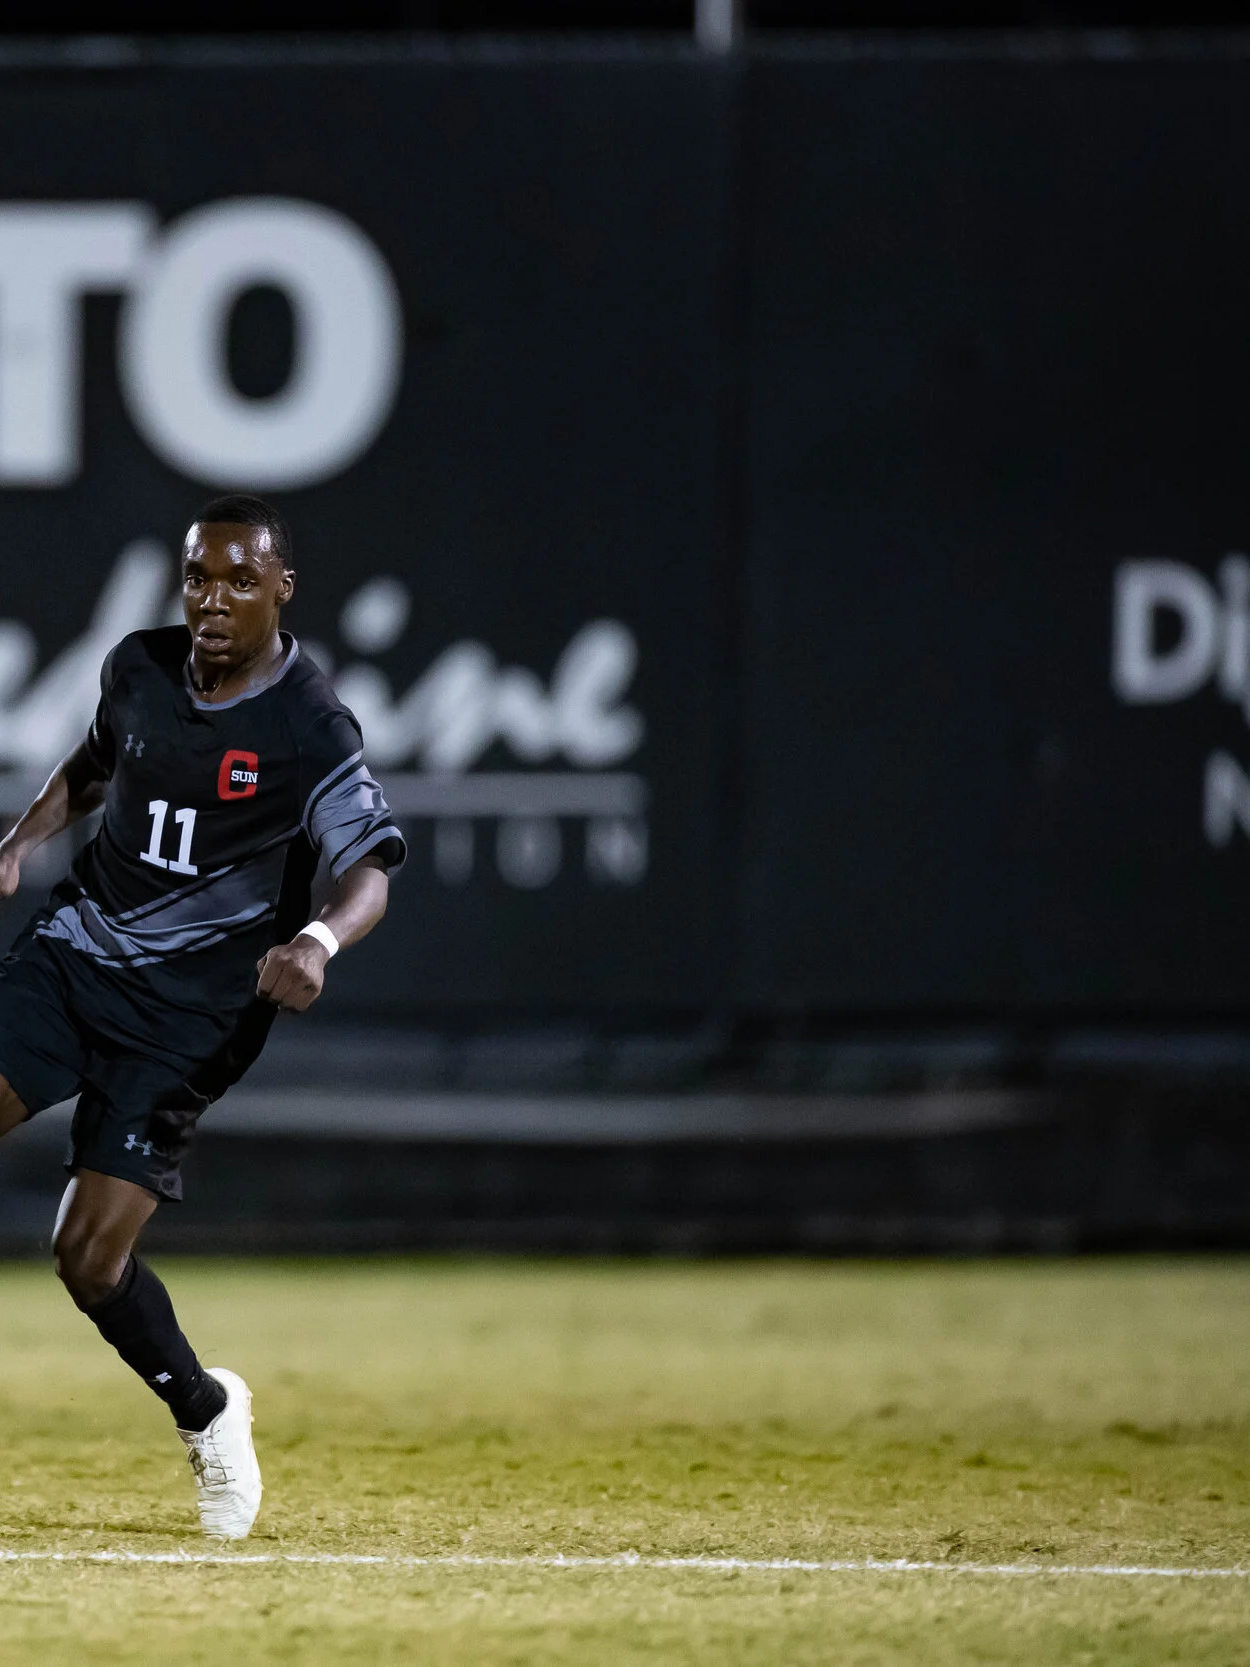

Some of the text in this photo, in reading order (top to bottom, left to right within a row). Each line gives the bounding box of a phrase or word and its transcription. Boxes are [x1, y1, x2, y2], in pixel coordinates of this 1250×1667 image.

[1111, 551, 1250, 728] Di
[230, 769, 259, 784] SUN
[139, 799, 199, 876] 11
